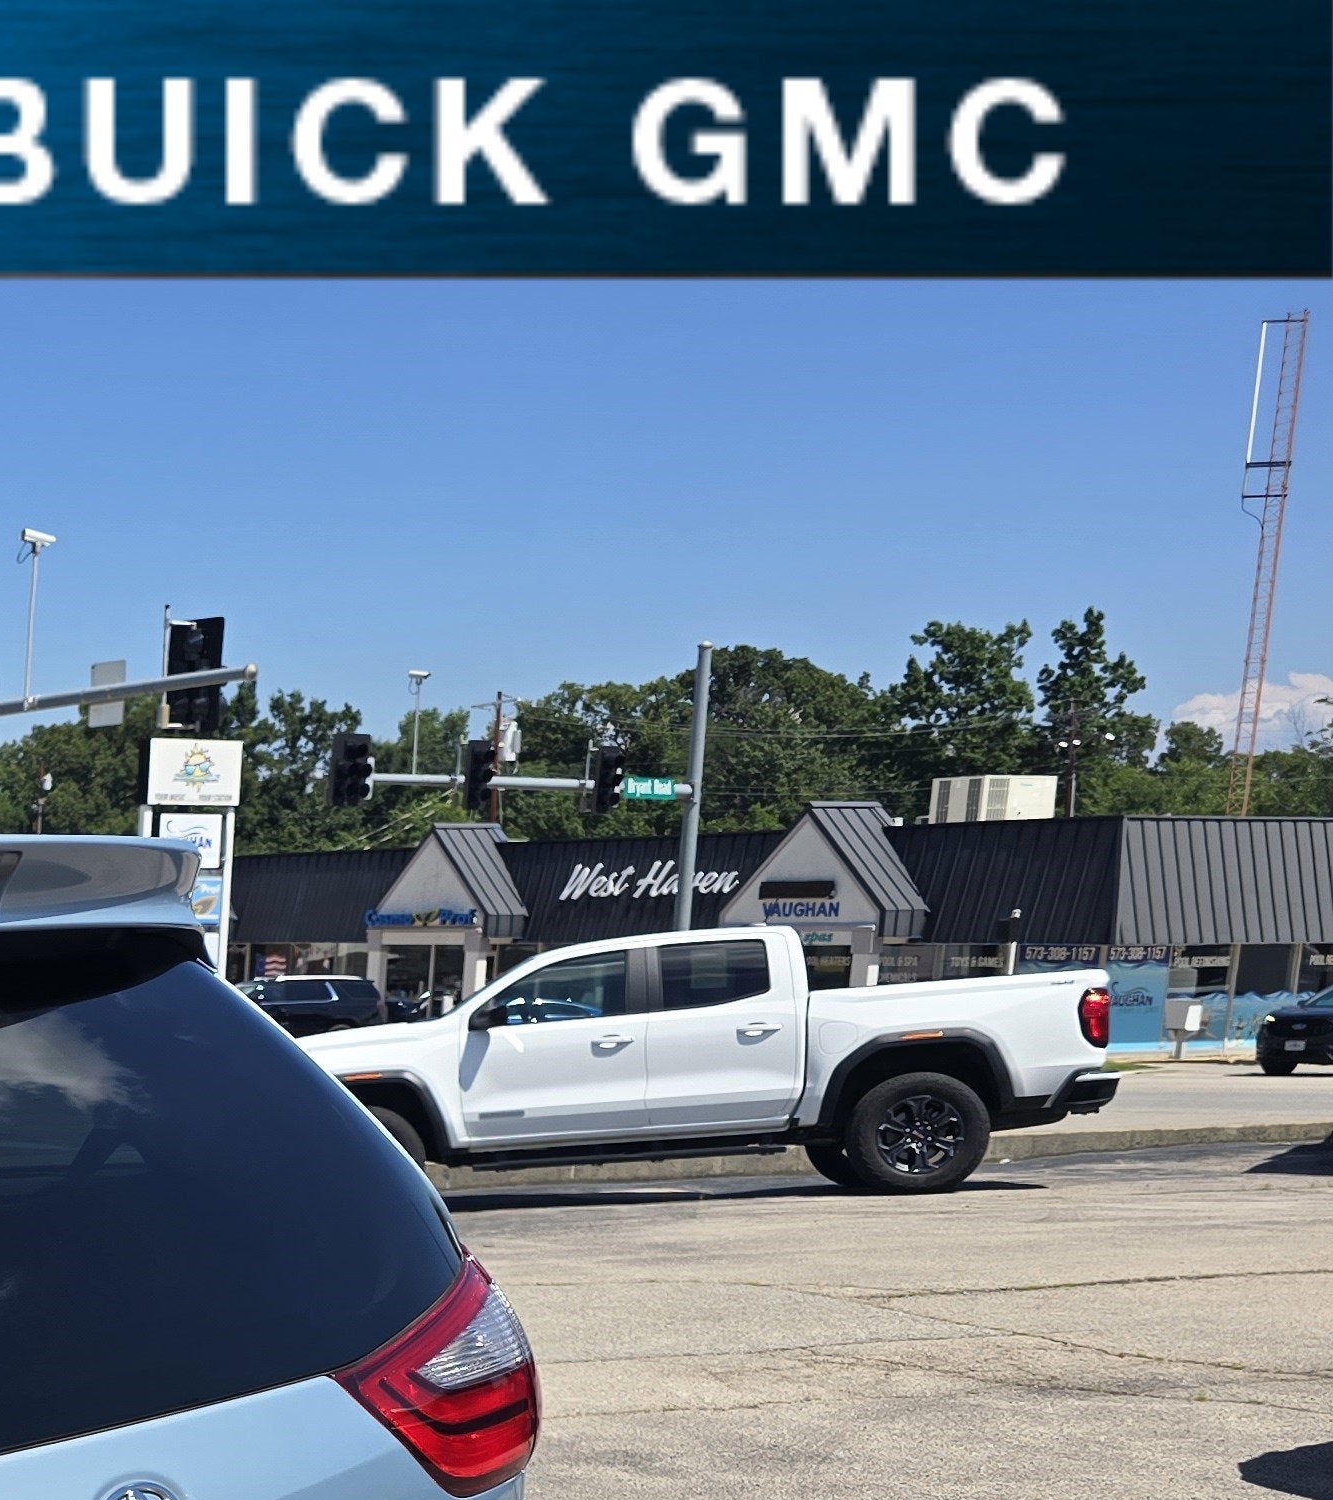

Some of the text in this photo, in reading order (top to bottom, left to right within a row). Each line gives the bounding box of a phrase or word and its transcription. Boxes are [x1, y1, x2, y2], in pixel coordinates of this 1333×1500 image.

[559, 862, 636, 901] West
[762, 902, 840, 917] VAUGHAN
[1025, 946, 1096, 961] 573-308-1157
[1109, 946, 1167, 961] 573-308-1157
